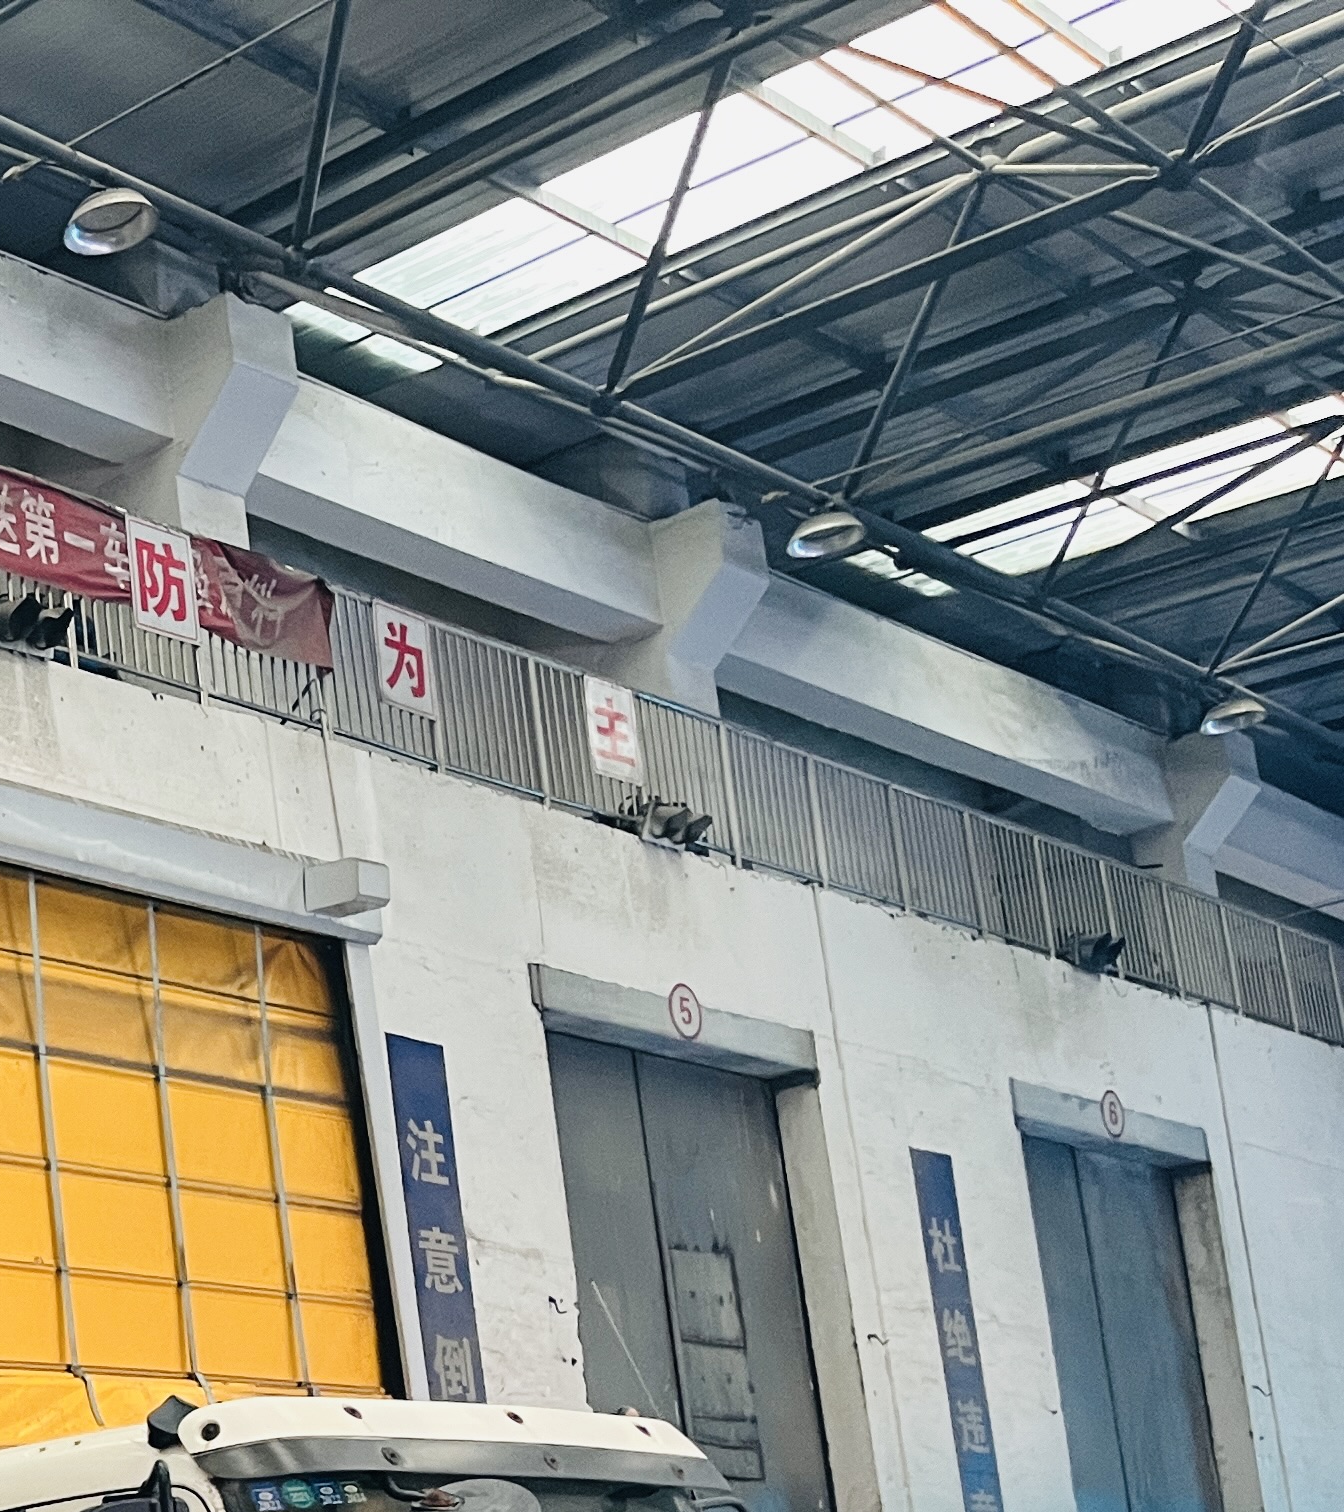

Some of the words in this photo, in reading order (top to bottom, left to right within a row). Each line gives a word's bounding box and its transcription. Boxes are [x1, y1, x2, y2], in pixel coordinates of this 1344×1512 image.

[135, 538, 186, 622] 防
[384, 622, 426, 698] 为
[678, 1000, 692, 1026] 5
